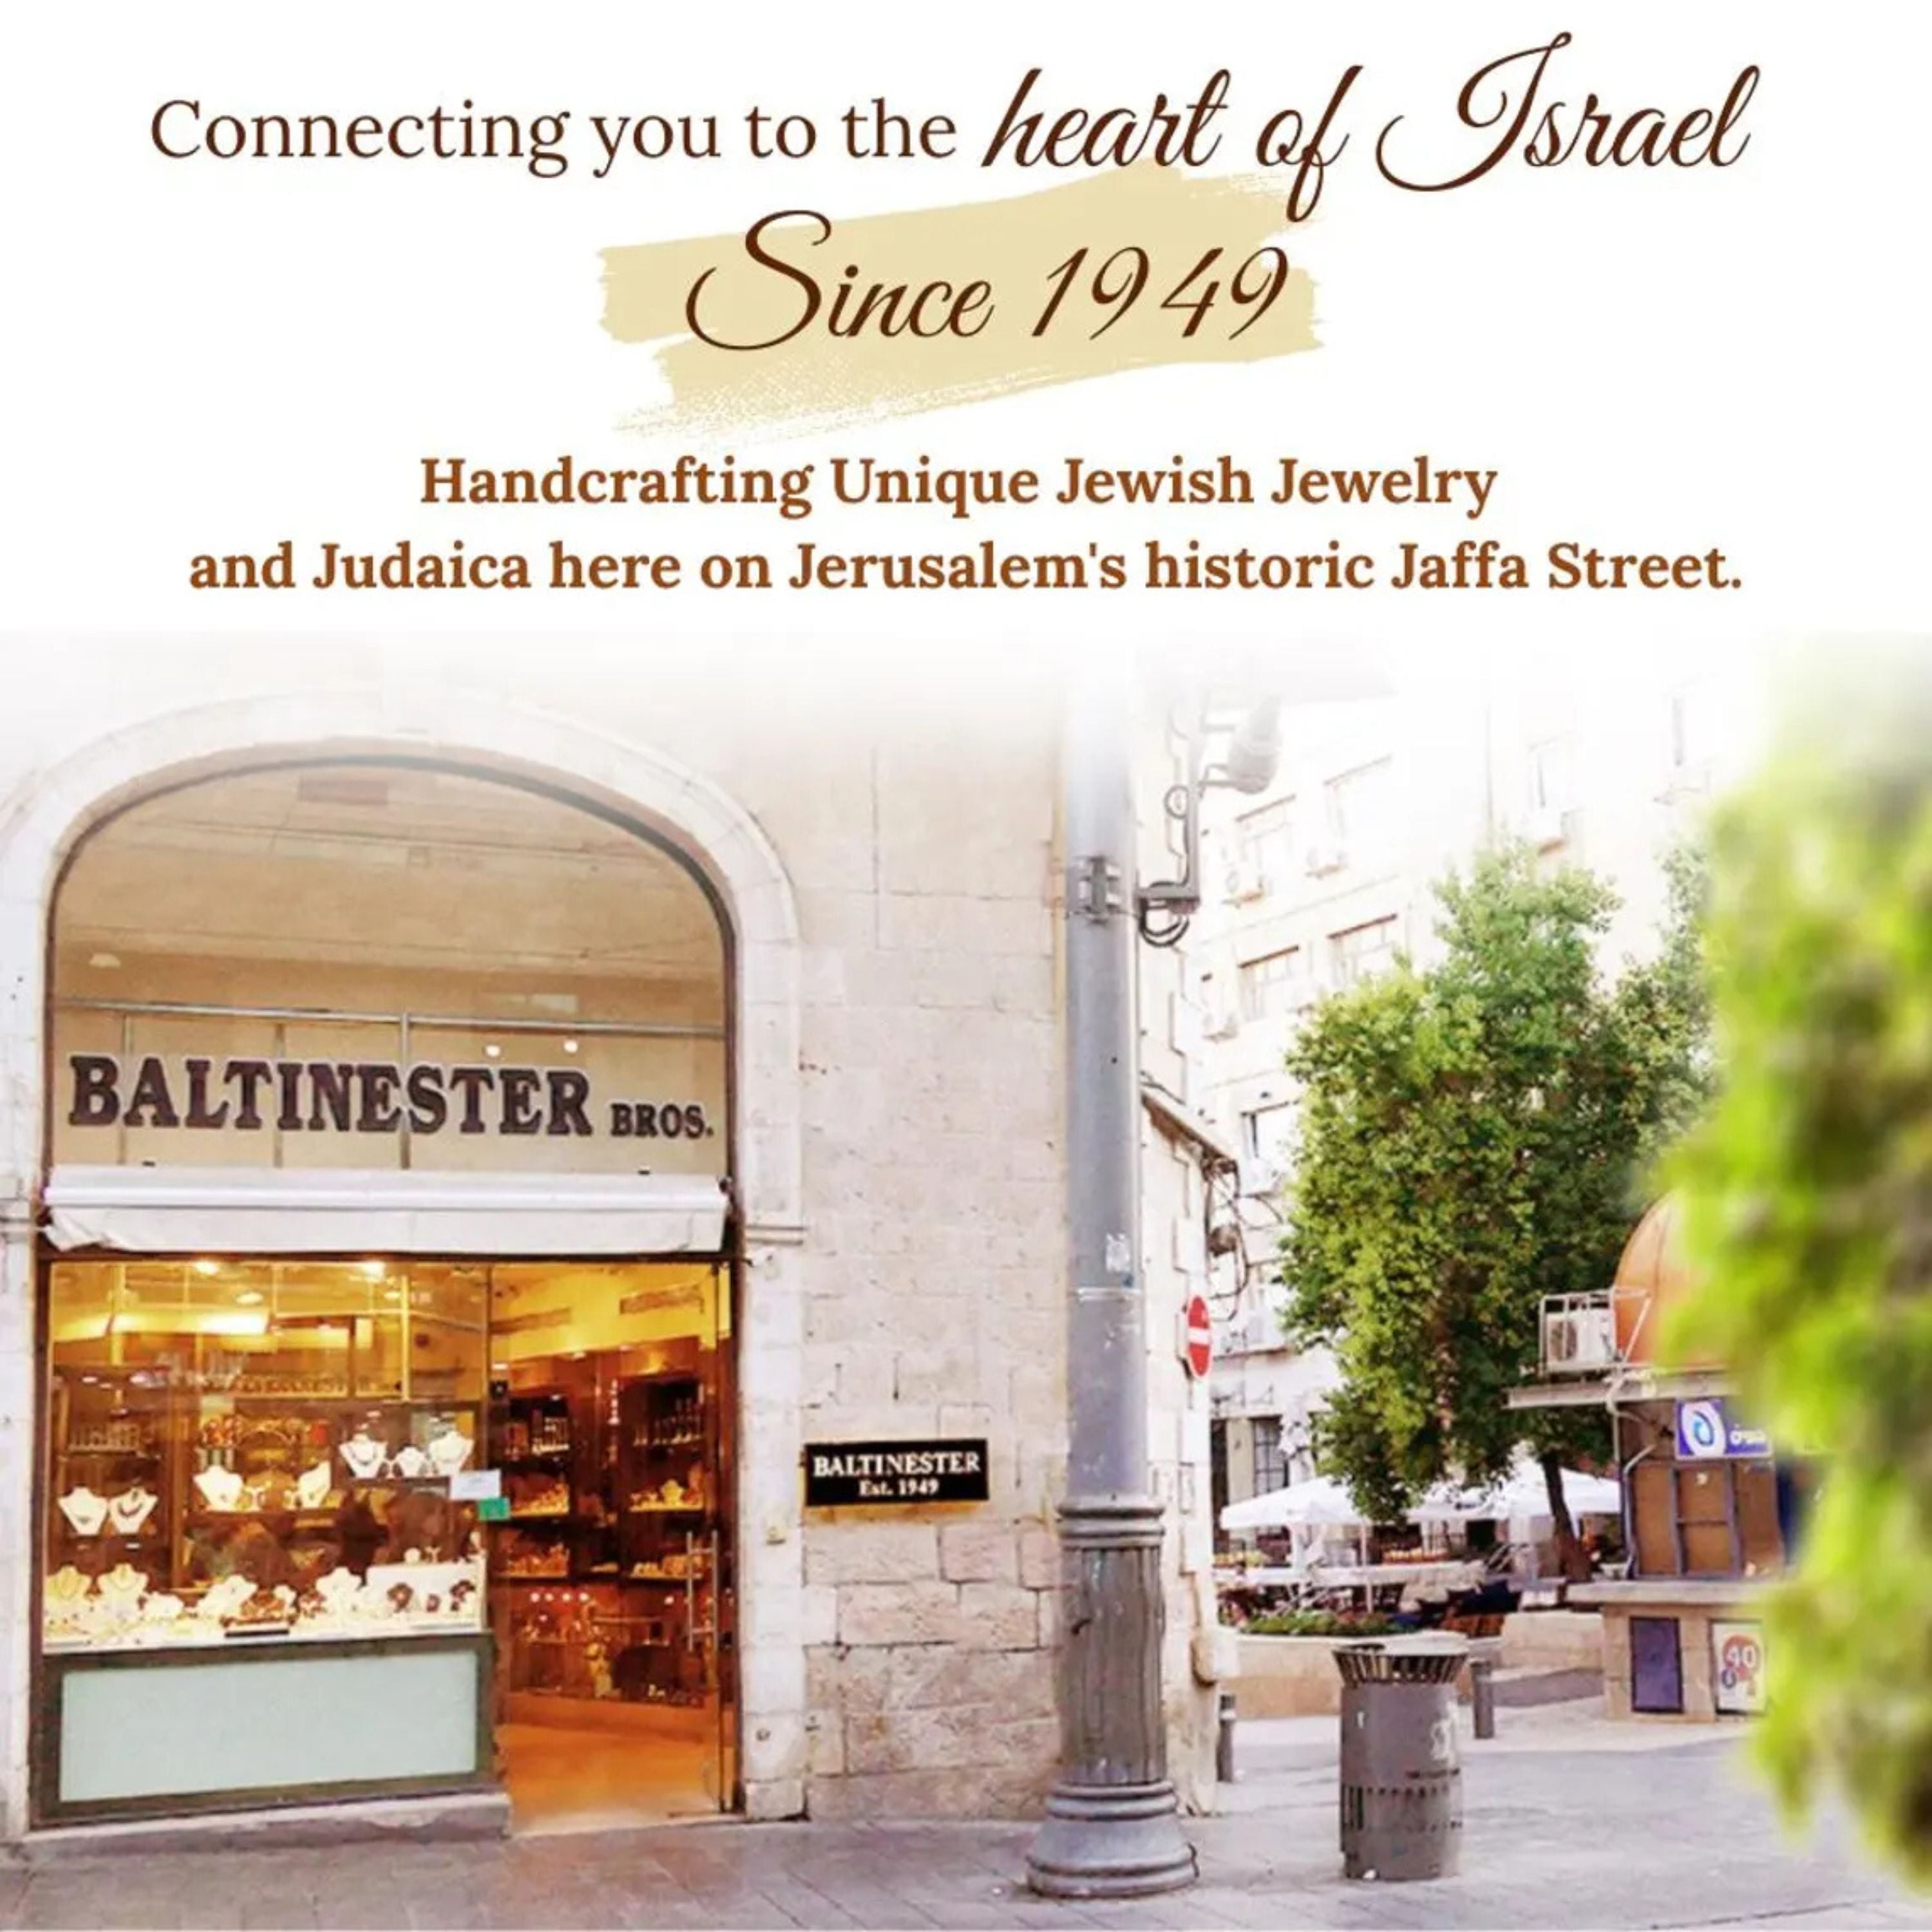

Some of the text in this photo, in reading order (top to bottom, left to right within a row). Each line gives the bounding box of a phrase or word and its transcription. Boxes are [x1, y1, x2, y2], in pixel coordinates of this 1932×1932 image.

[68, 1055, 714, 1140] BALTINESTER BROS.
[813, 1452, 981, 1477] BALTINESTER
[859, 1479, 939, 1496] Est. 1949
